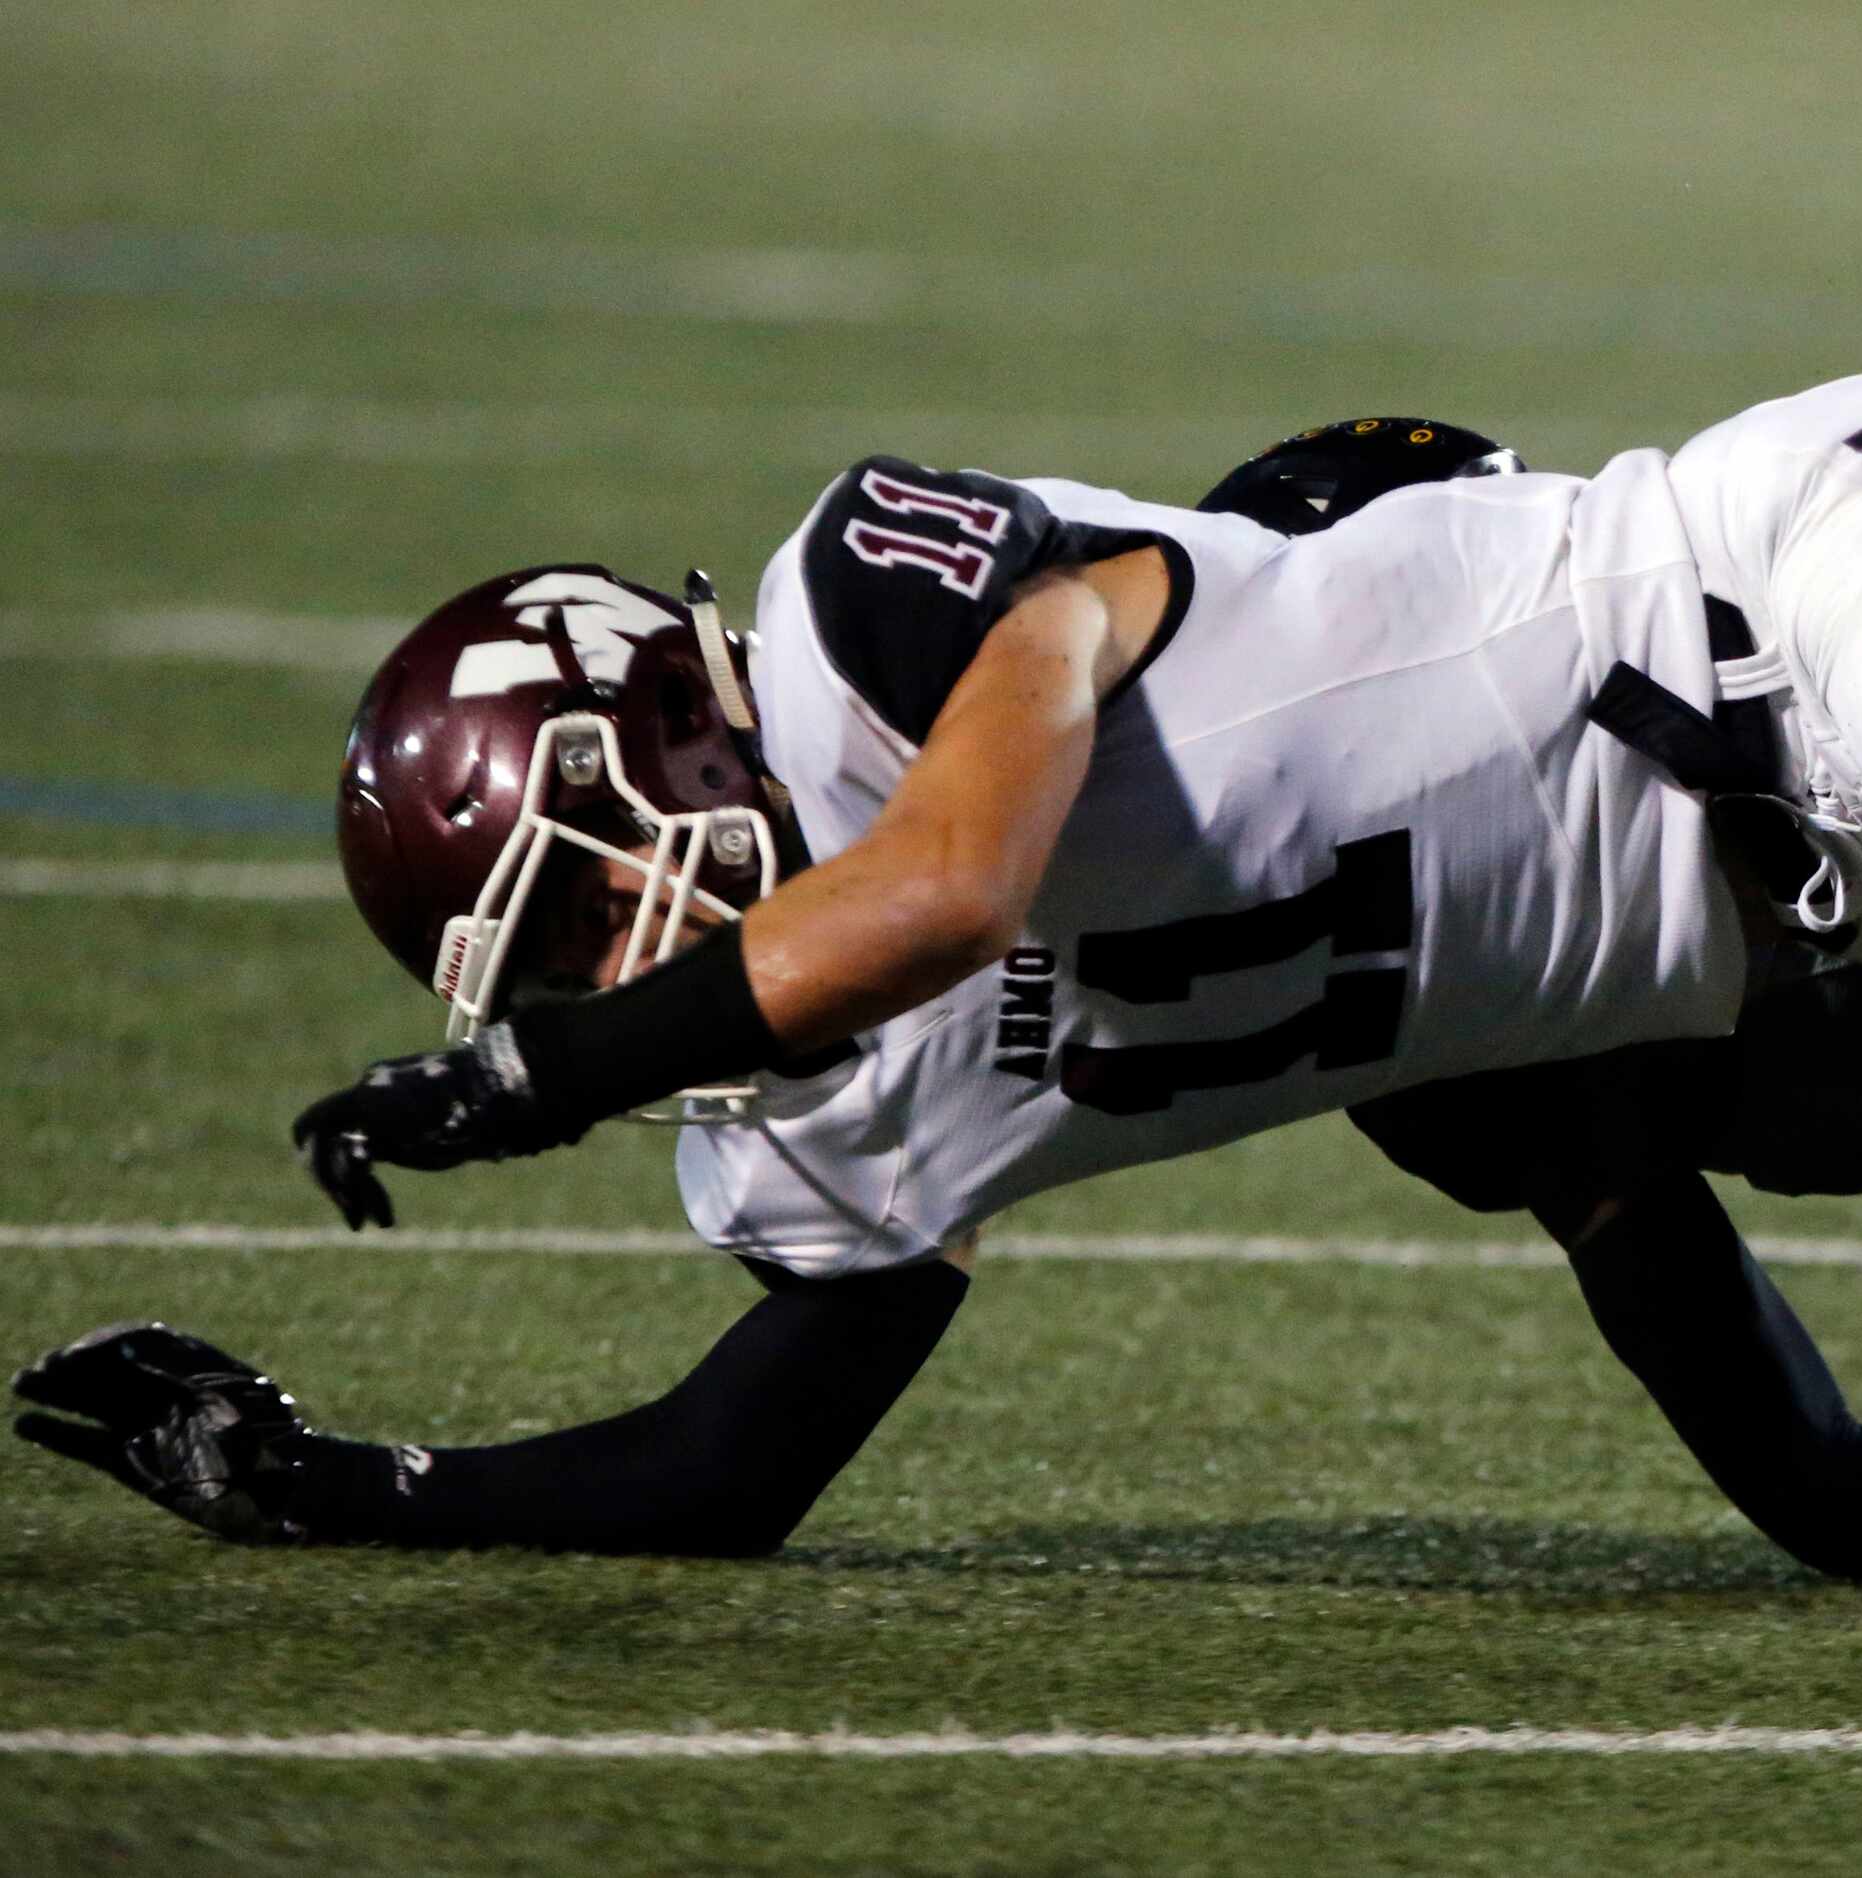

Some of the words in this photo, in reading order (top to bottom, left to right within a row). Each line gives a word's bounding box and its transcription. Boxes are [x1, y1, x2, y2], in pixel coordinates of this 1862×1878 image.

[842, 468, 1011, 600] 11
[994, 946, 1055, 1082] AHMO
[1061, 827, 1414, 1116] 11
